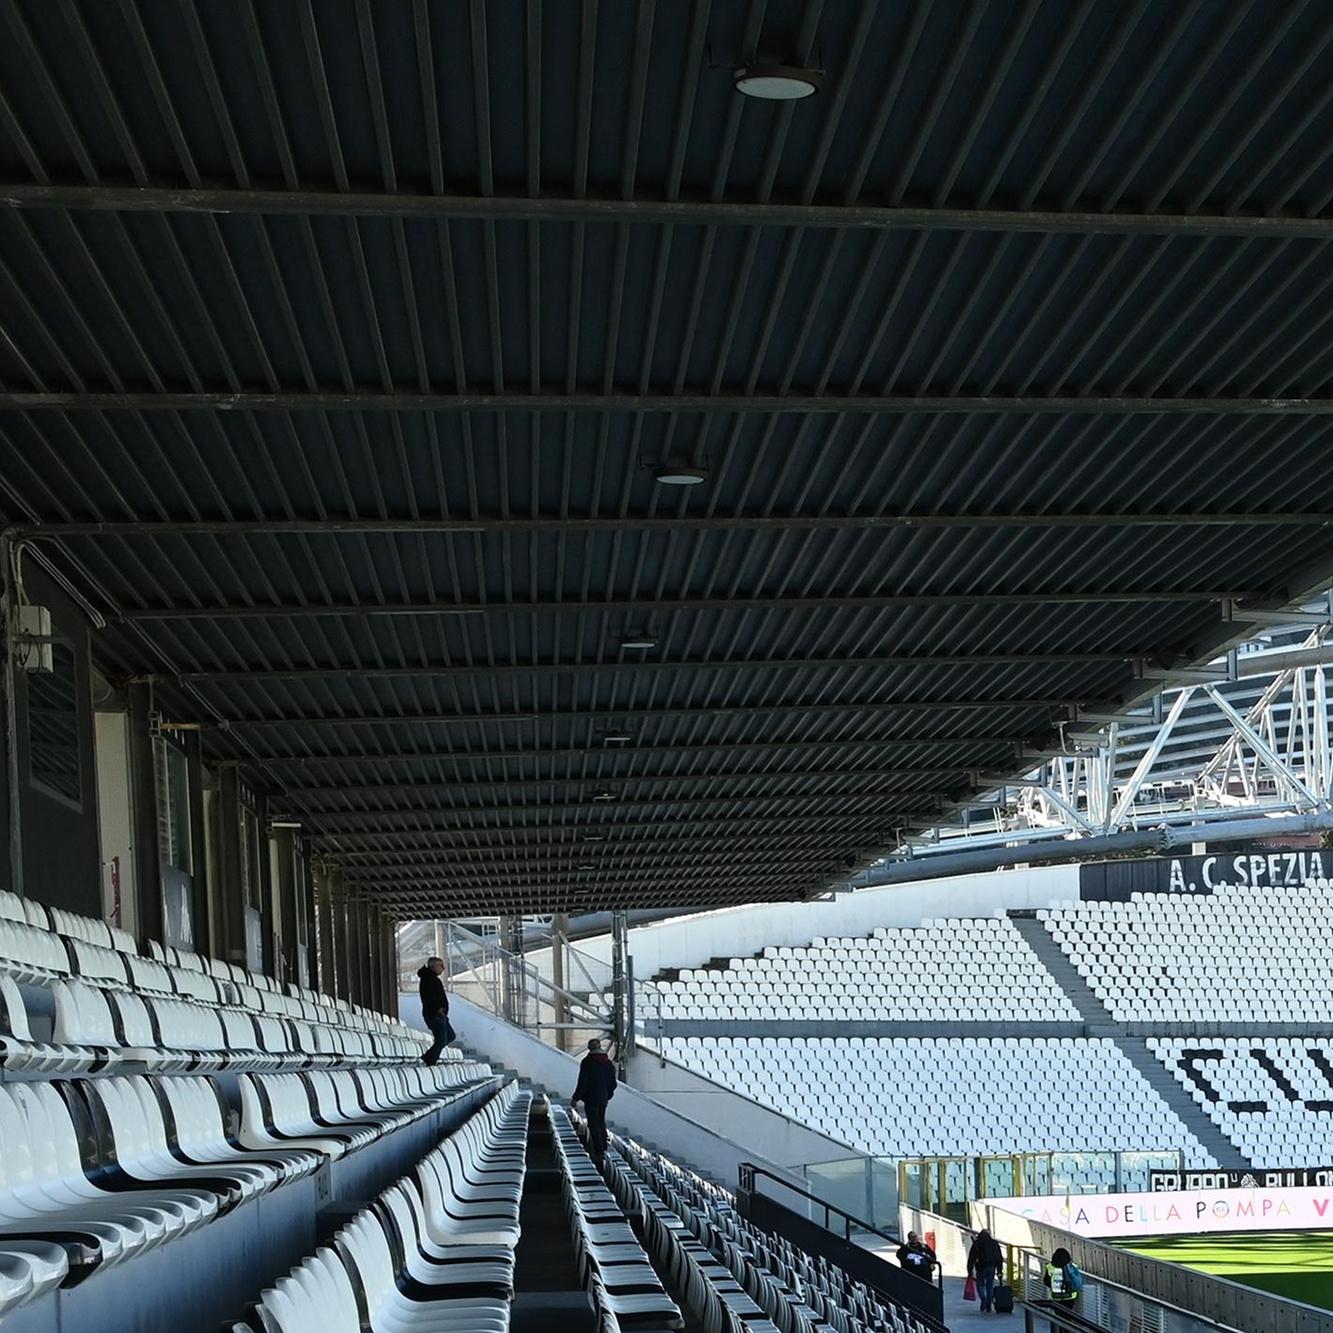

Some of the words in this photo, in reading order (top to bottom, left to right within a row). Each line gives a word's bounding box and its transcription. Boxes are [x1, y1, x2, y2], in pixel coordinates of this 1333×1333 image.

[1233, 852, 1325, 887] SPEZIA
[1106, 1204, 1181, 1224] DELLA
[1197, 1199, 1291, 1220] POMPA
